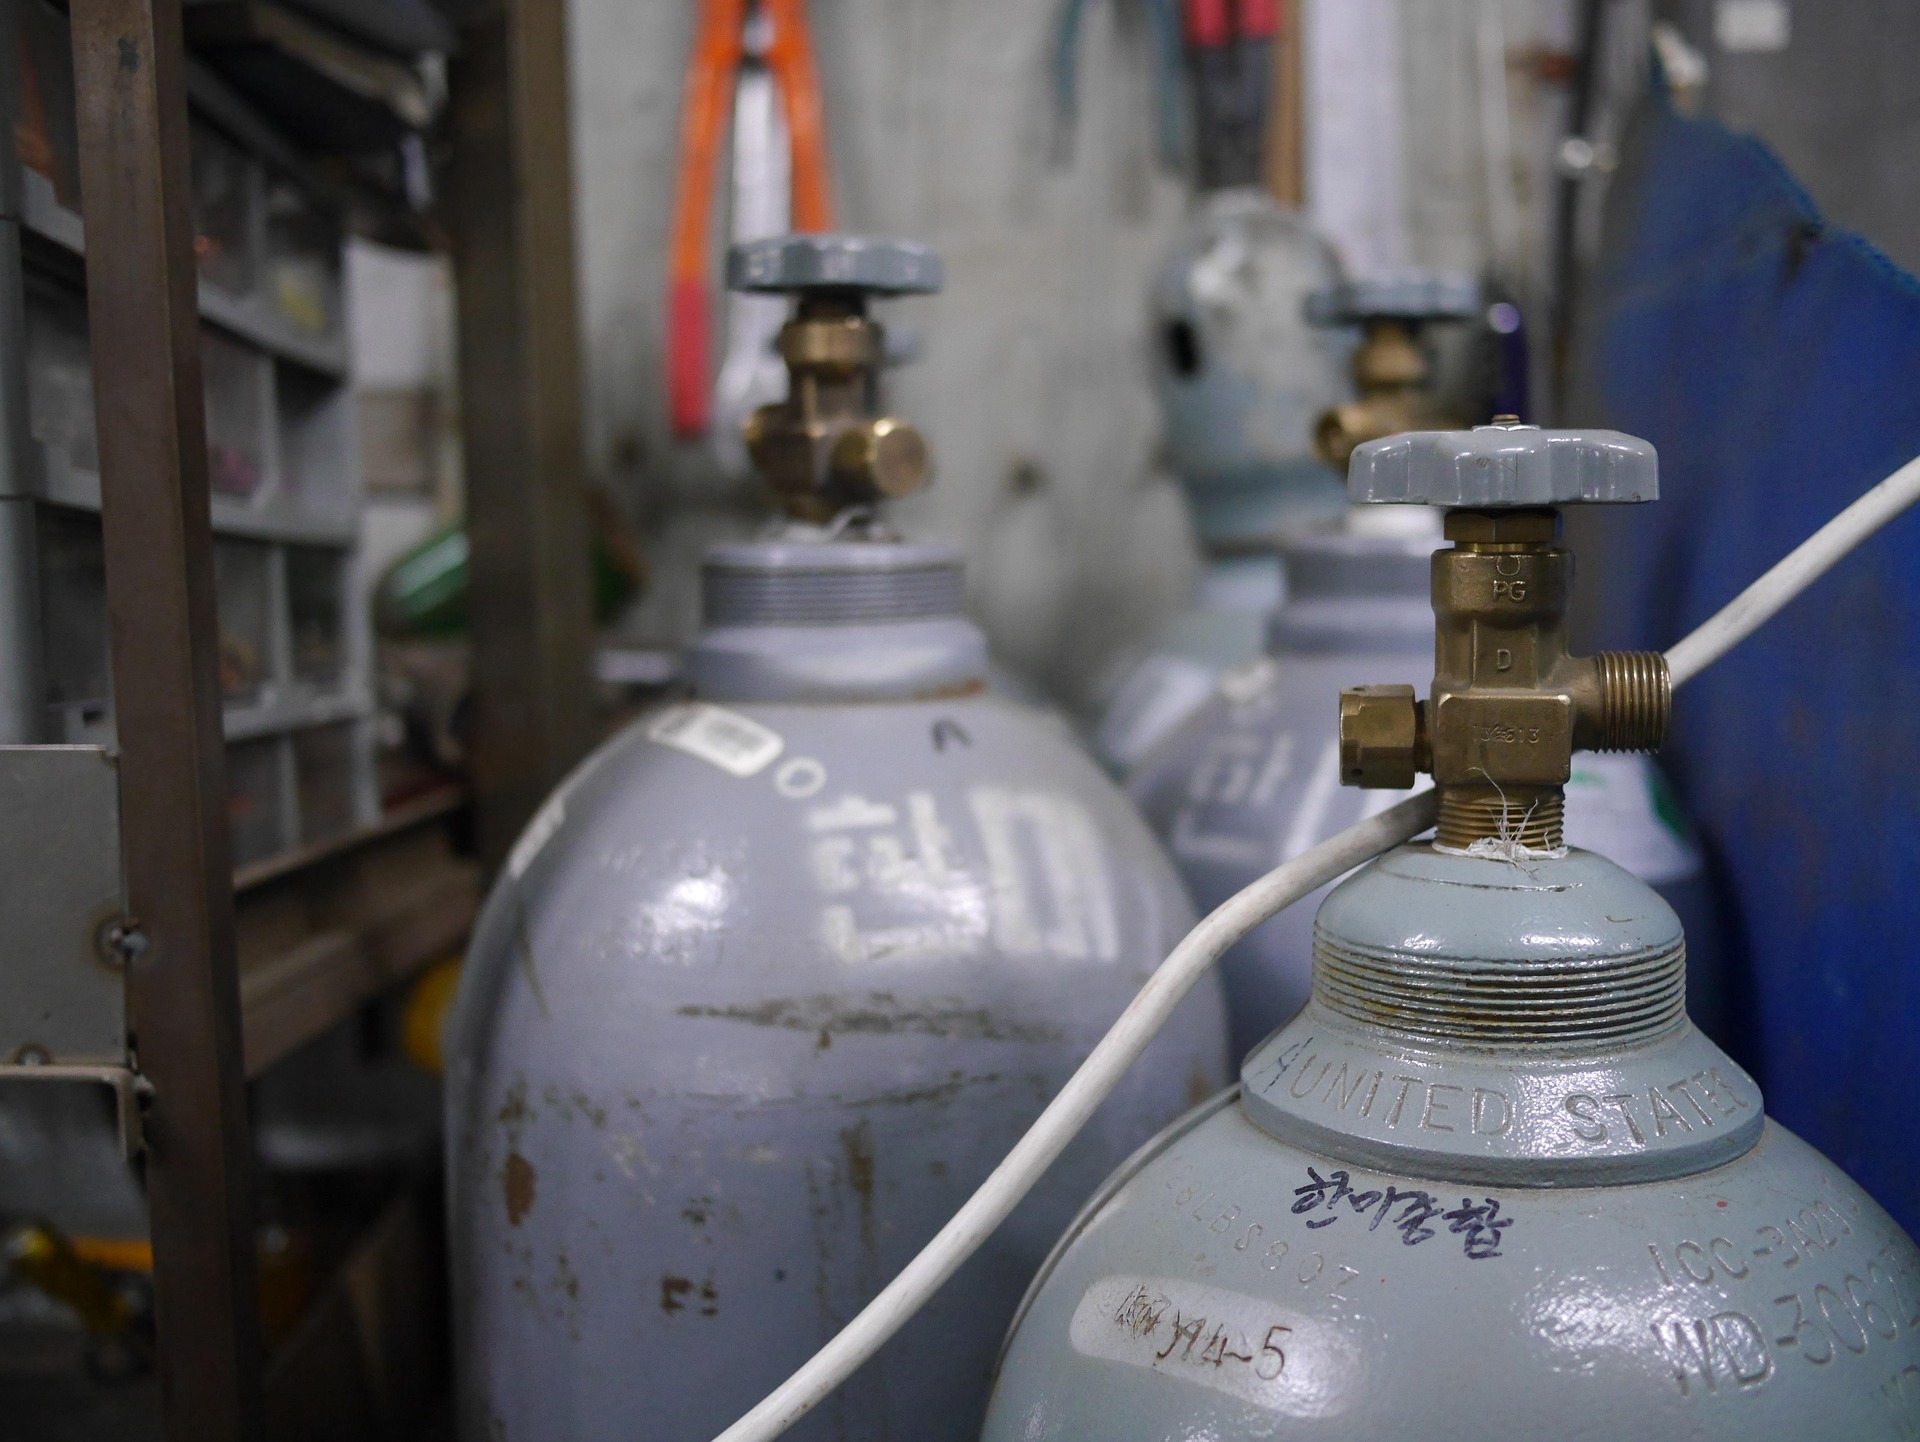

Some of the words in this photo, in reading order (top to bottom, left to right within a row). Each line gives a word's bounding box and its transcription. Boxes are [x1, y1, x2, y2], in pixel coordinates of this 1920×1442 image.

[1493, 580, 1526, 601] PG
[1496, 648, 1512, 671] D
[1288, 1054, 1515, 1136] UNITED
[1561, 1066, 1750, 1146] STATES
